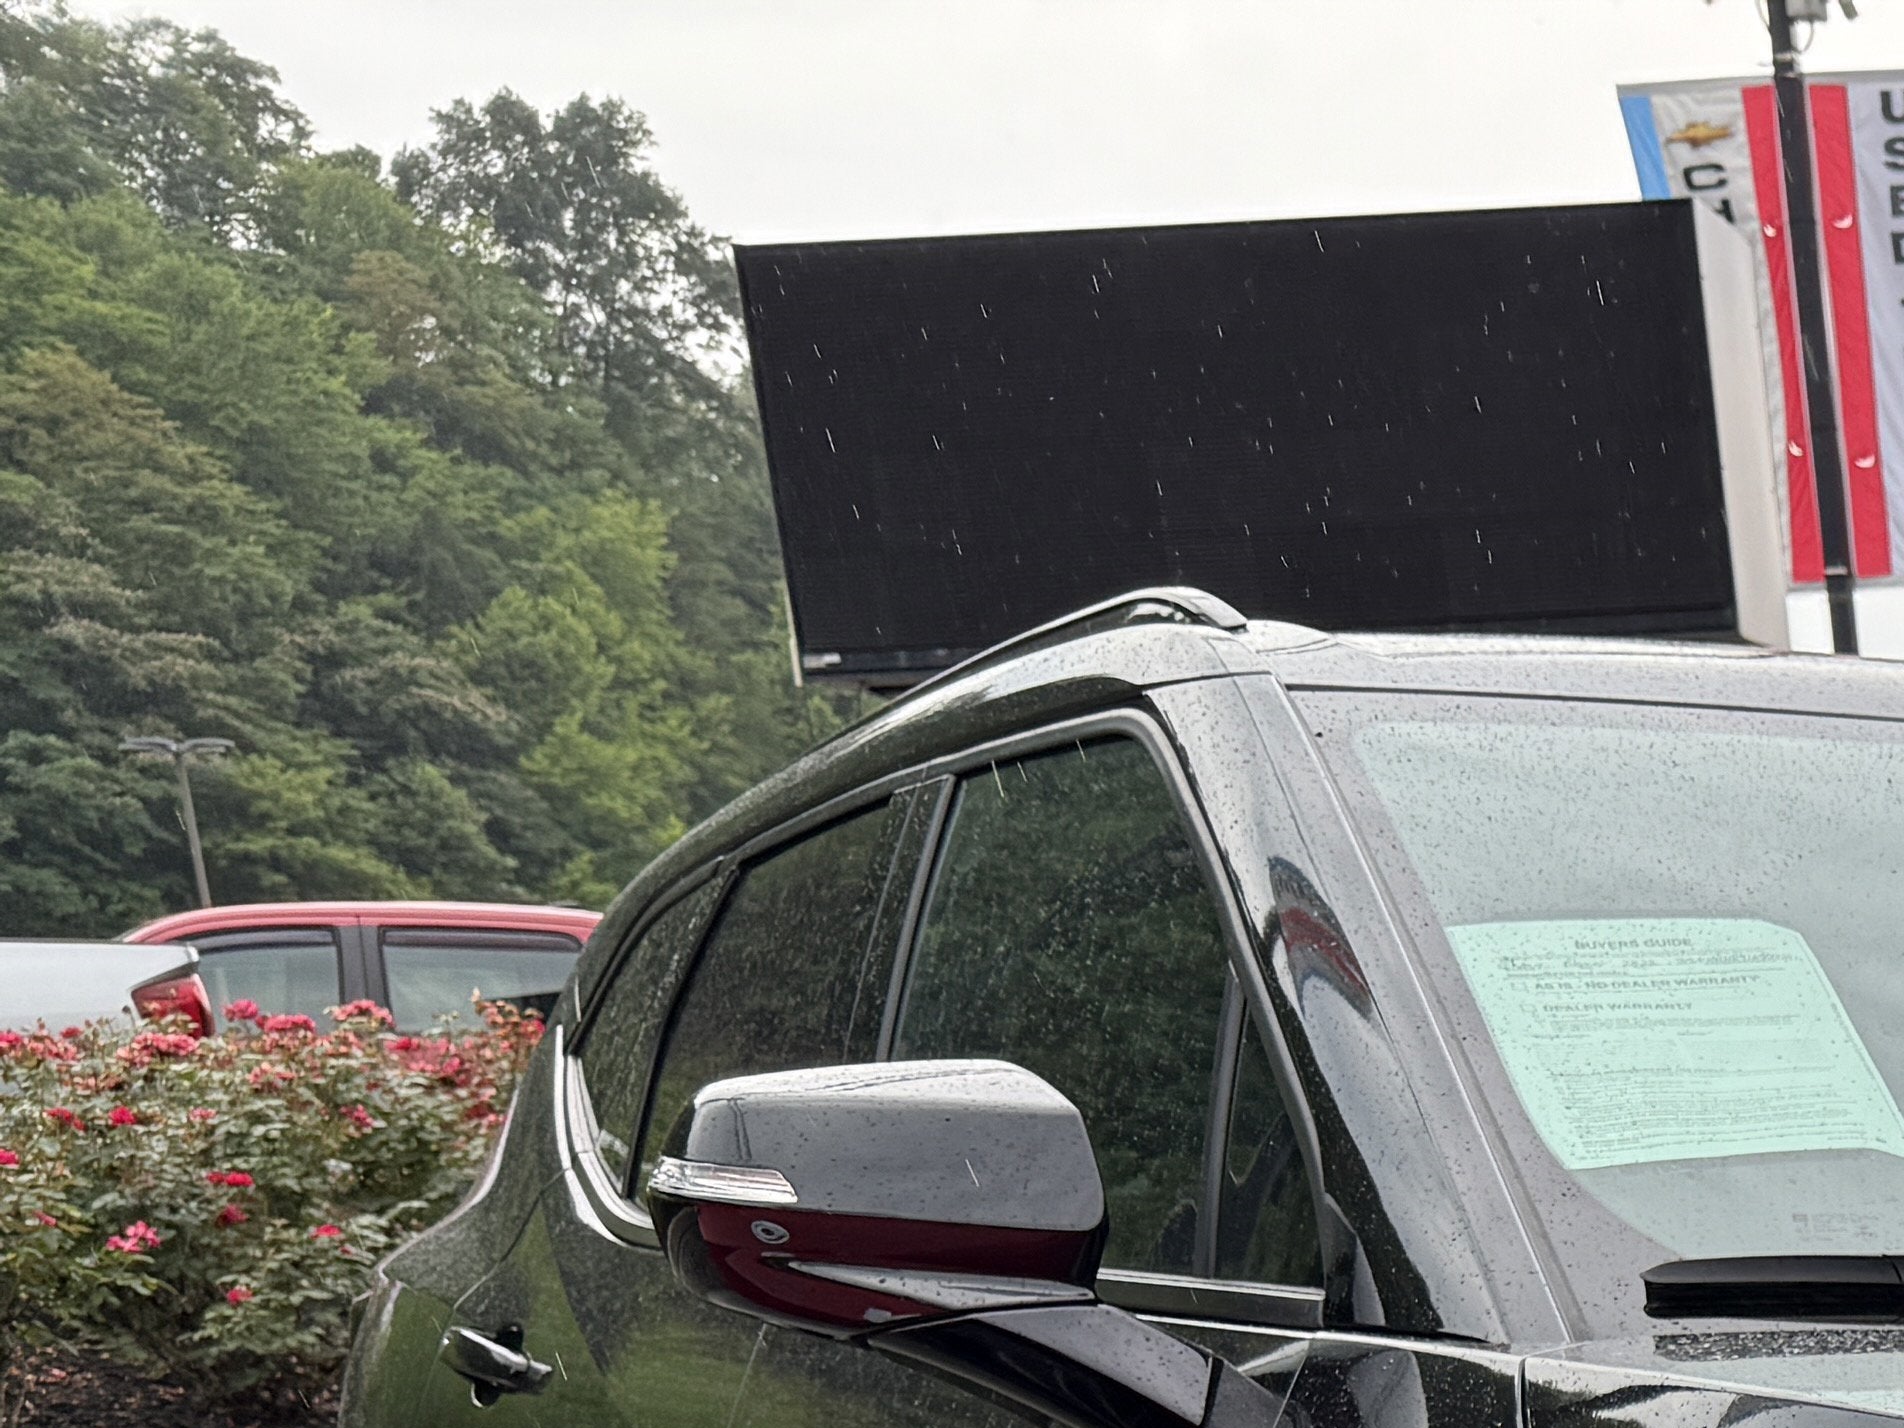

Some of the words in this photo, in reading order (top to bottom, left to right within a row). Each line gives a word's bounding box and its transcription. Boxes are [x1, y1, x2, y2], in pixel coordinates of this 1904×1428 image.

[1574, 939, 1640, 951] BUYERS
[1643, 938, 1693, 949] GUIDE
[1608, 977, 1672, 991] DEALER
[1675, 975, 1761, 988] WARRANTY
[1543, 1002, 1604, 1014] DEALER
[1608, 1001, 1693, 1012] WARRANTY
